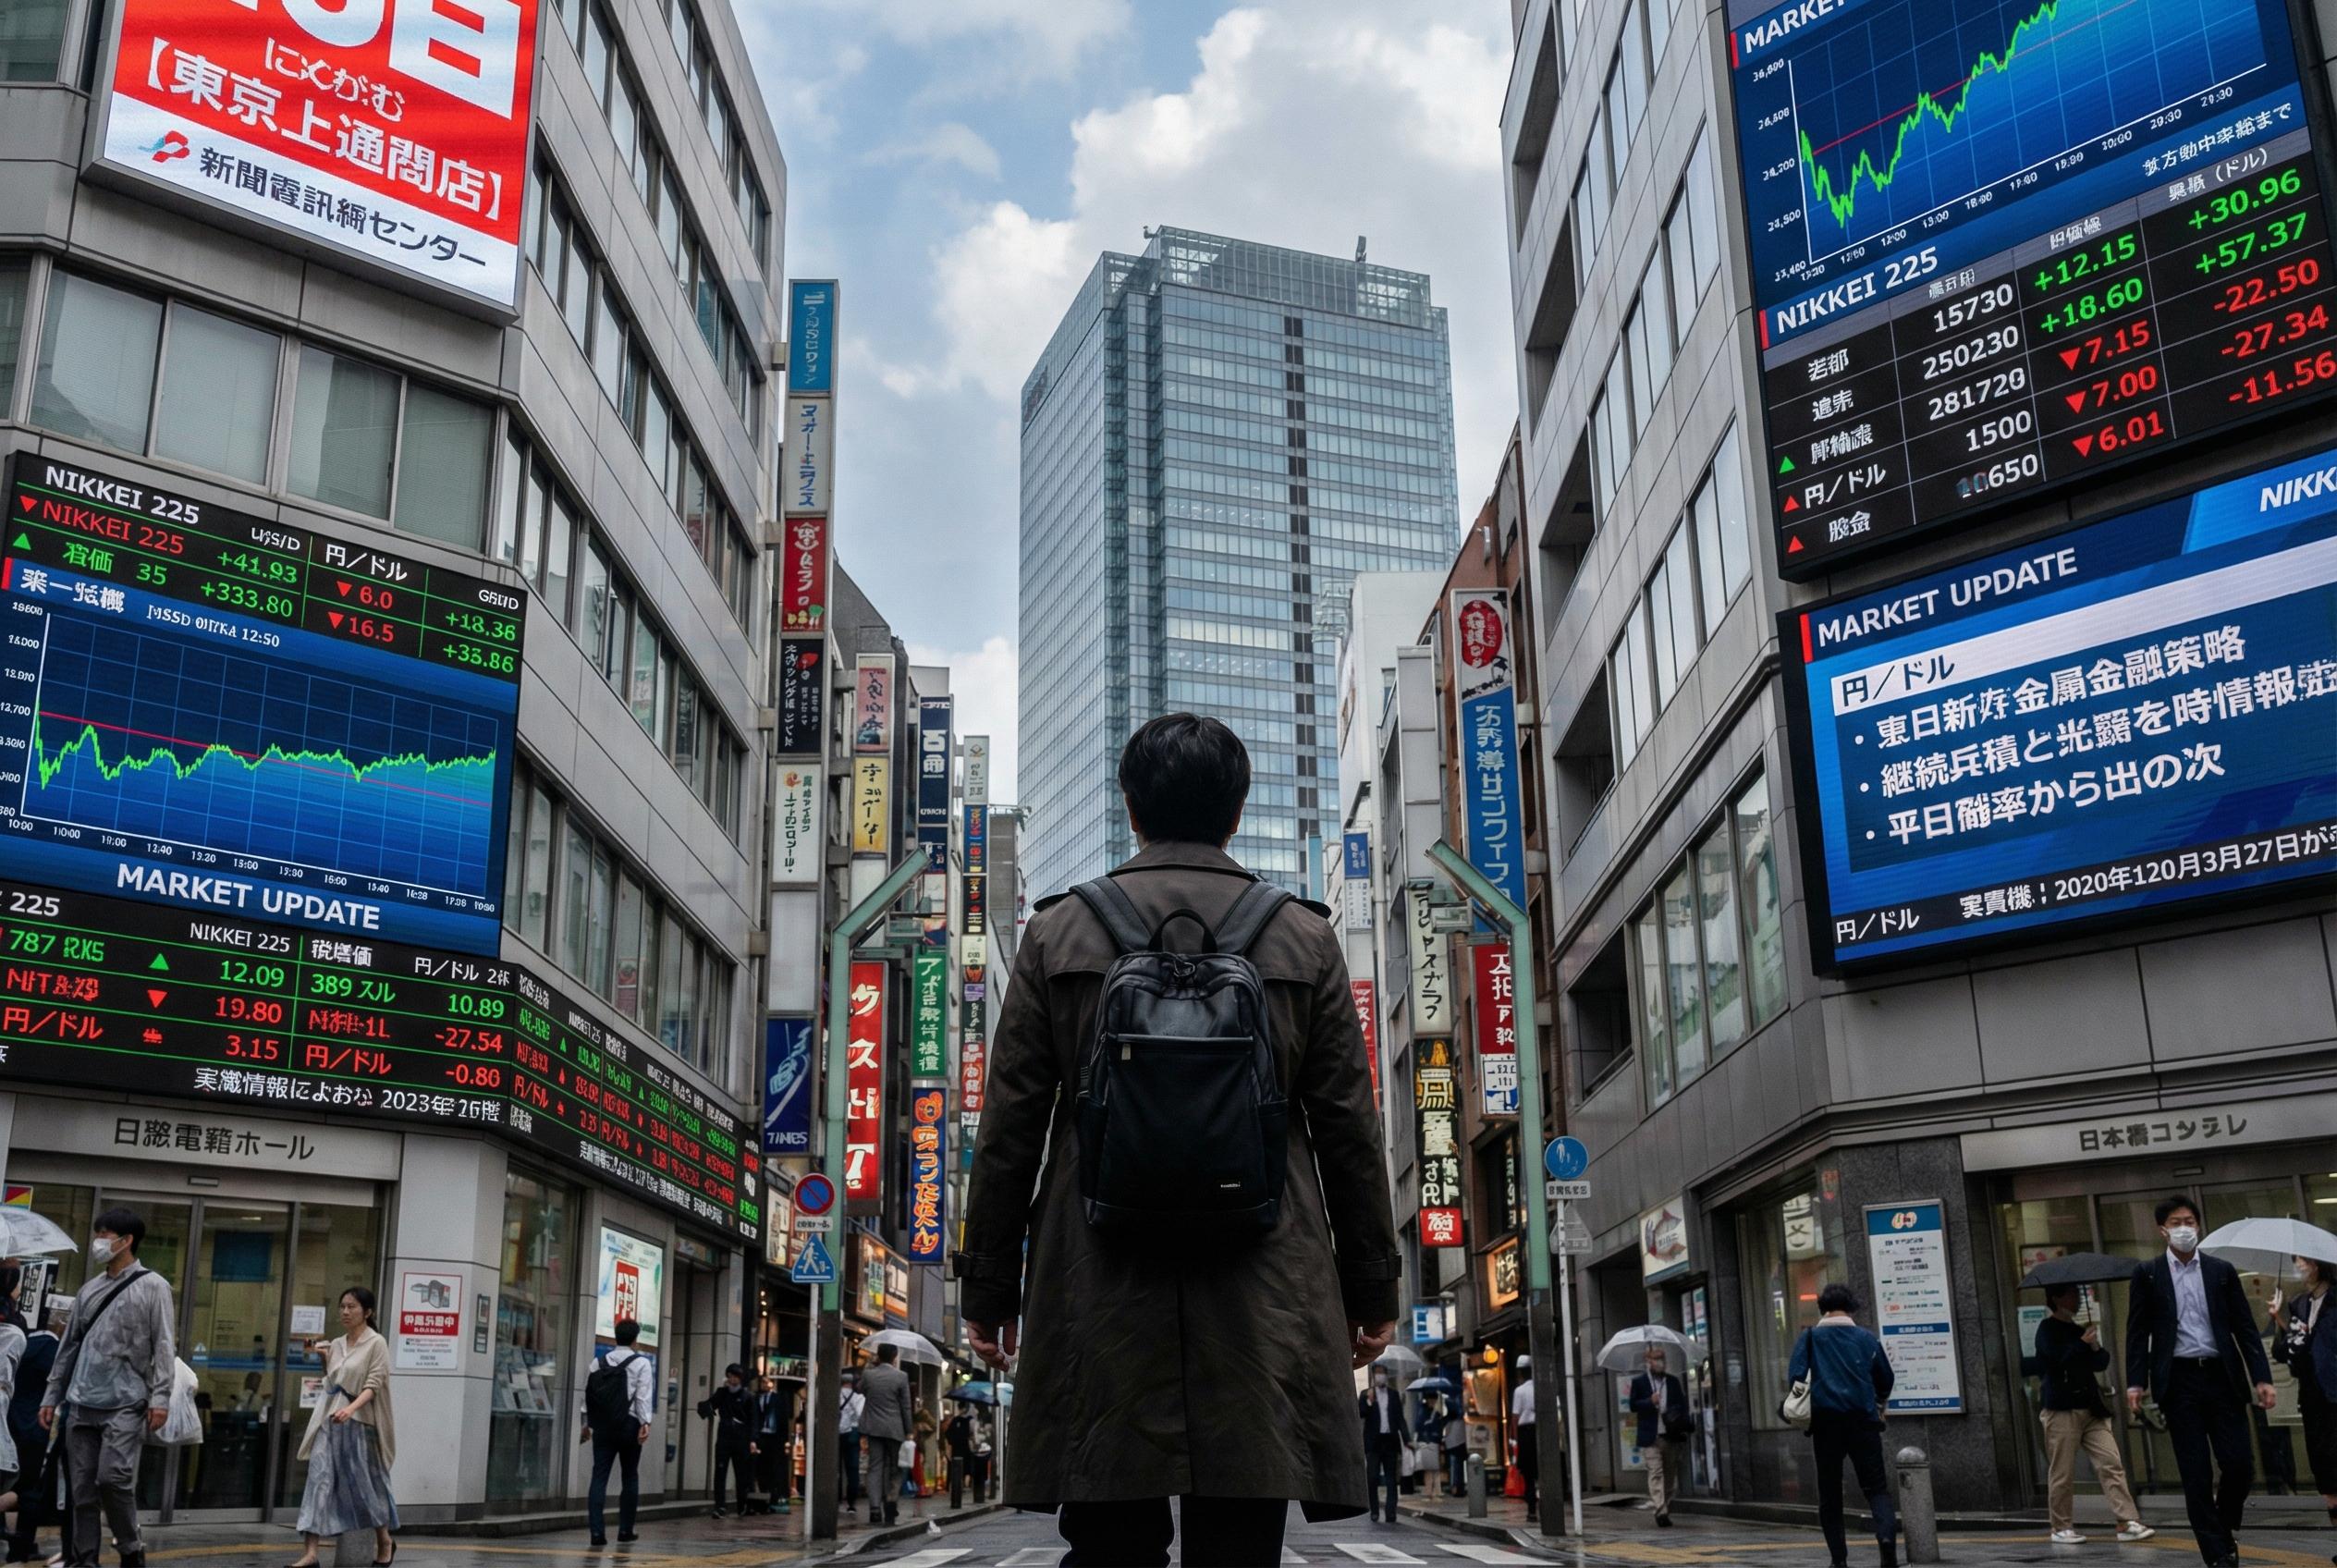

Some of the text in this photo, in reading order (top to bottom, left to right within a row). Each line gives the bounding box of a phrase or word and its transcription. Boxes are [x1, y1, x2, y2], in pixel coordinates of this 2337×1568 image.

[1744, 0, 1846, 54] MARKE
[1934, 283, 2013, 332] 15730
[2036, 234, 2135, 291] +12.15
[2189, 169, 2301, 230] +30.96
[1777, 272, 1876, 334] NIKKEI
[1884, 247, 1939, 289] 225
[1923, 325, 2019, 380] 250230
[2041, 278, 2143, 333] +18.60
[2196, 212, 2306, 274] +57.37
[2085, 320, 2149, 364] 7.15
[2213, 259, 2319, 313] -22.50
[1966, 304, 2330, 452] 1500 7.00 -27.34
[2099, 411, 2164, 451] 6.01
[2229, 350, 2336, 405] -11.56
[43, 500, 131, 541] NIKKEI
[138, 526, 185, 555] 225
[46, 465, 200, 524] NIKKEI 225
[136, 562, 168, 585] 35
[1817, 547, 2078, 647] MARKET UPDATE
[201, 582, 293, 618] +333.80
[349, 616, 395, 643] 16.5
[9, 892, 60, 917] 225
[258, 932, 291, 953] 225
[117, 863, 381, 931] MARKET UPDATE
[9, 929, 55, 955] 787
[220, 960, 285, 987] 12.09
[311, 973, 352, 997] 389
[448, 993, 505, 1019] 10.89
[215, 996, 282, 1023] 19.80
[434, 1027, 502, 1053] -27.54
[225, 1035, 279, 1060] 3.15
[445, 1063, 501, 1087] -0.80
